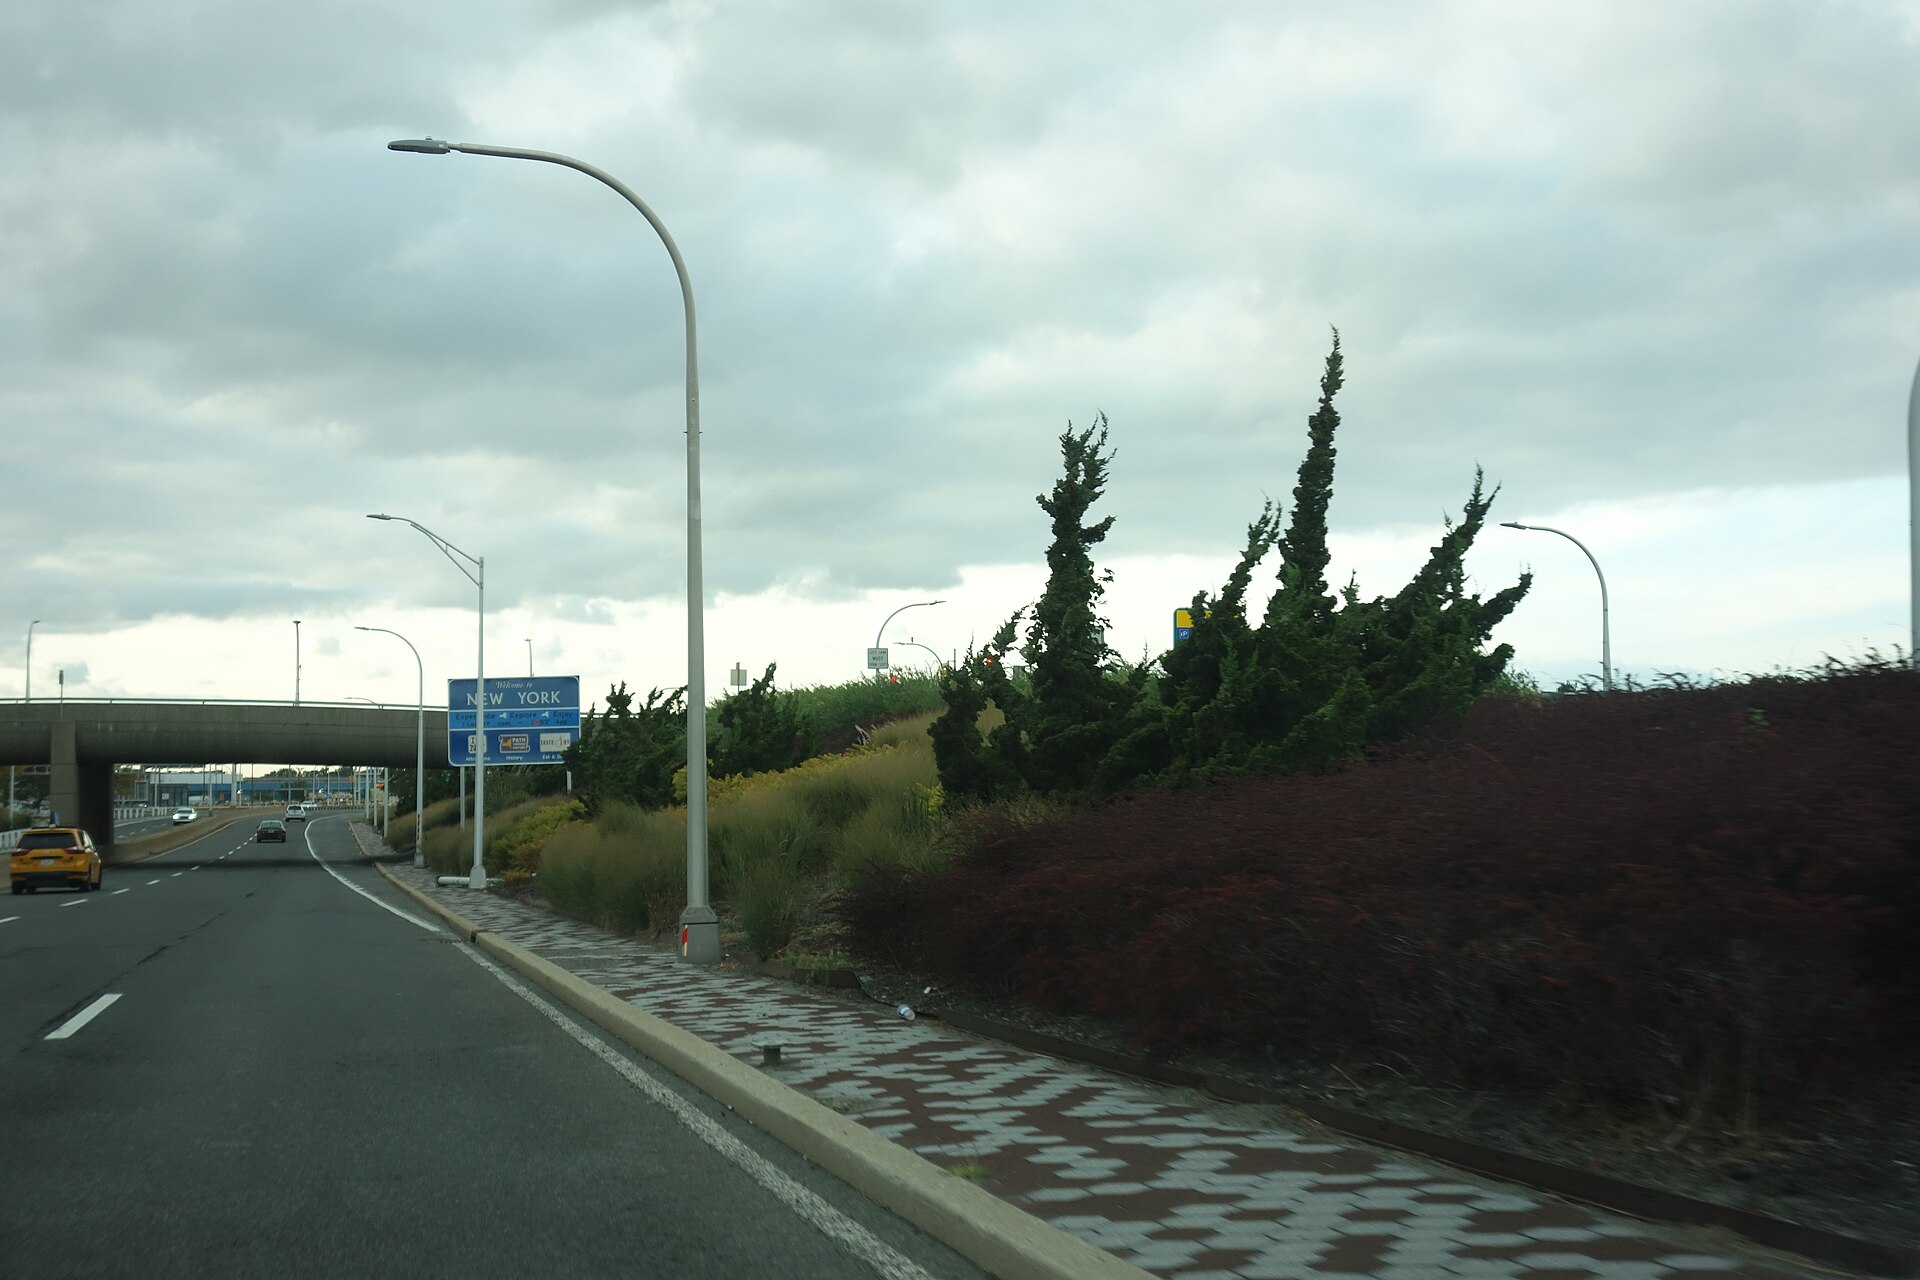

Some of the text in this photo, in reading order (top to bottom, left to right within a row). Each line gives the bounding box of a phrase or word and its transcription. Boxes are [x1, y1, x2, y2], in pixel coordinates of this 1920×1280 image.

[467, 691, 560, 705] NEW YORK
[553, 711, 573, 719] Enjoy
